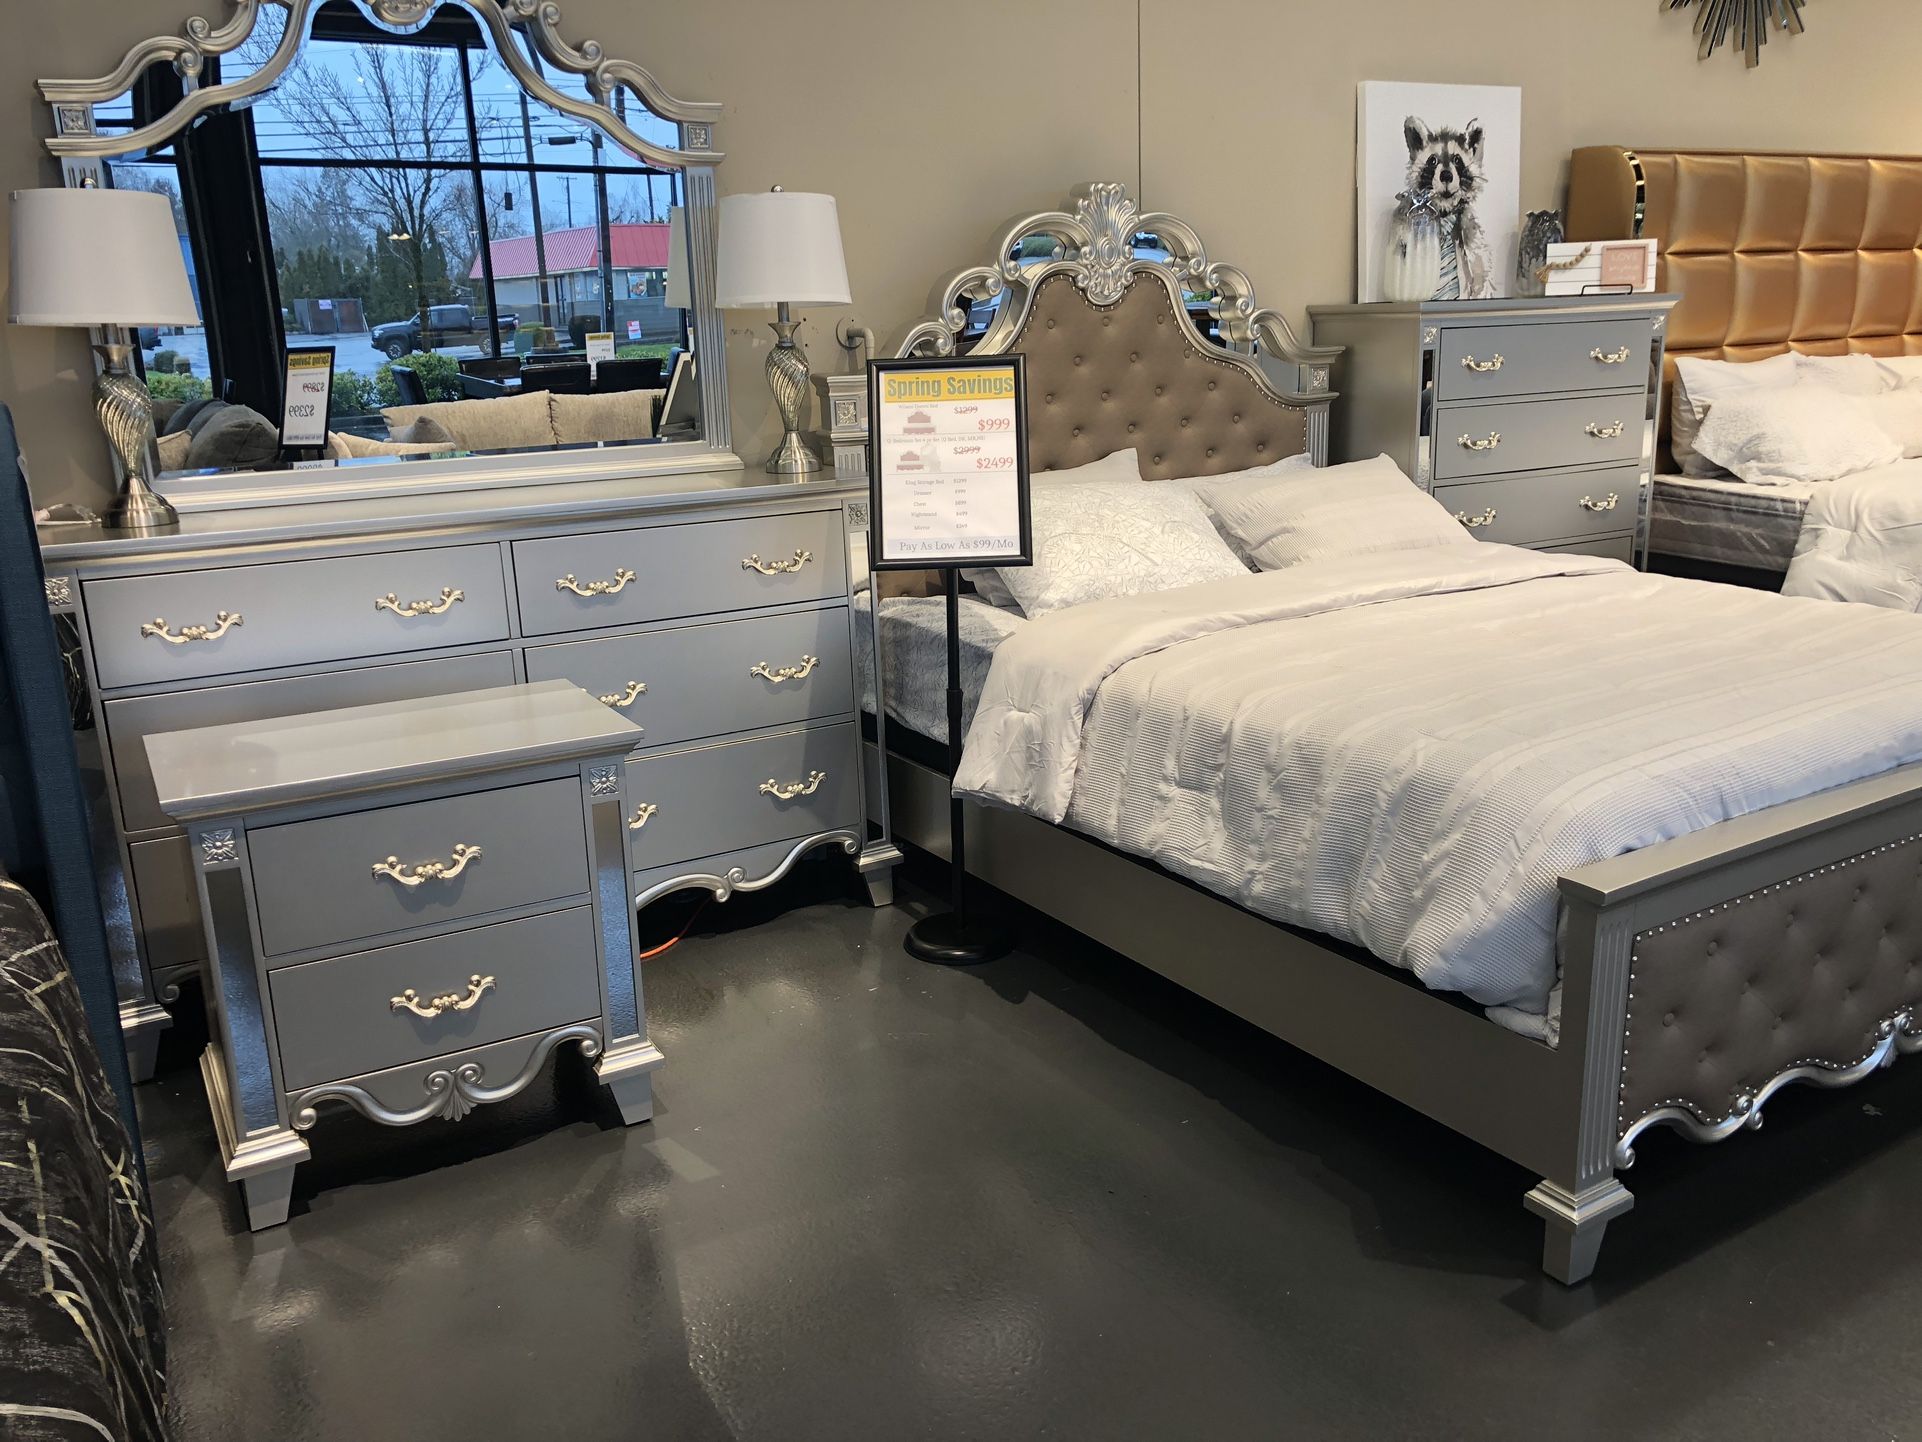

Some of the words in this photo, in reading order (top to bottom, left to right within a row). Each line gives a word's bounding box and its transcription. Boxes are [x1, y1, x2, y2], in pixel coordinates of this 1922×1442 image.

[887, 377, 941, 399] Spring
[947, 375, 1014, 395] Savings
[953, 405, 978, 415] $1299
[978, 418, 1010, 431] $999
[953, 446, 981, 455] $2999
[976, 457, 1014, 469] $2499
[900, 541, 918, 553] Pay
[921, 541, 932, 550] As
[935, 541, 955, 550] Low
[958, 540, 971, 549] As
[973, 539, 1014, 550] $99/Mo
